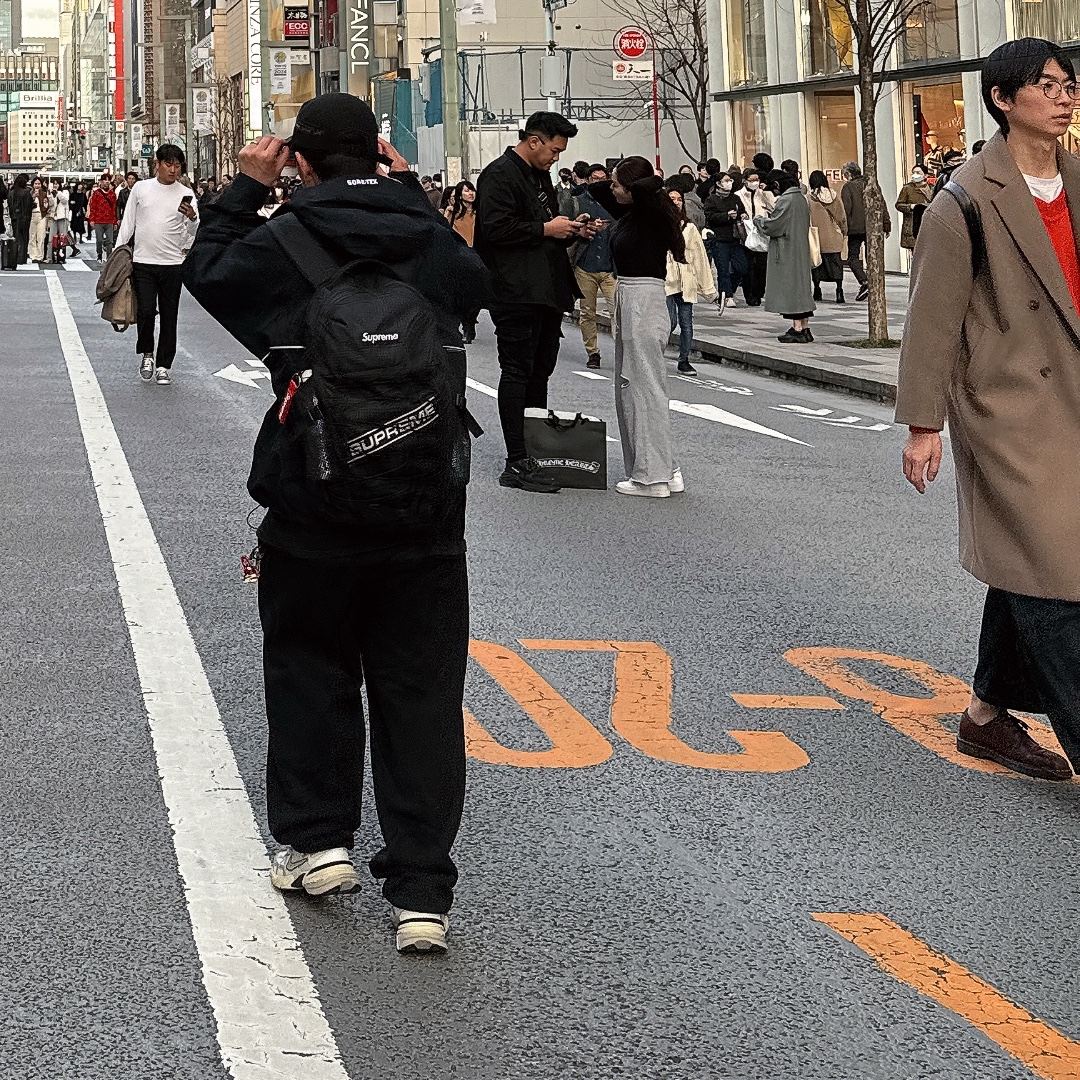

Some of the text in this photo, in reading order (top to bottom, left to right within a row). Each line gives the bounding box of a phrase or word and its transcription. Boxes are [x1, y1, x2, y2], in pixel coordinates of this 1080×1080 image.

[620, 38, 645, 50] 消火栓
[250, 42, 262, 86] CORE
[23, 94, 53, 102] Brillia
[361, 332, 399, 344] Supreme
[349, 403, 436, 457] SUPREME
